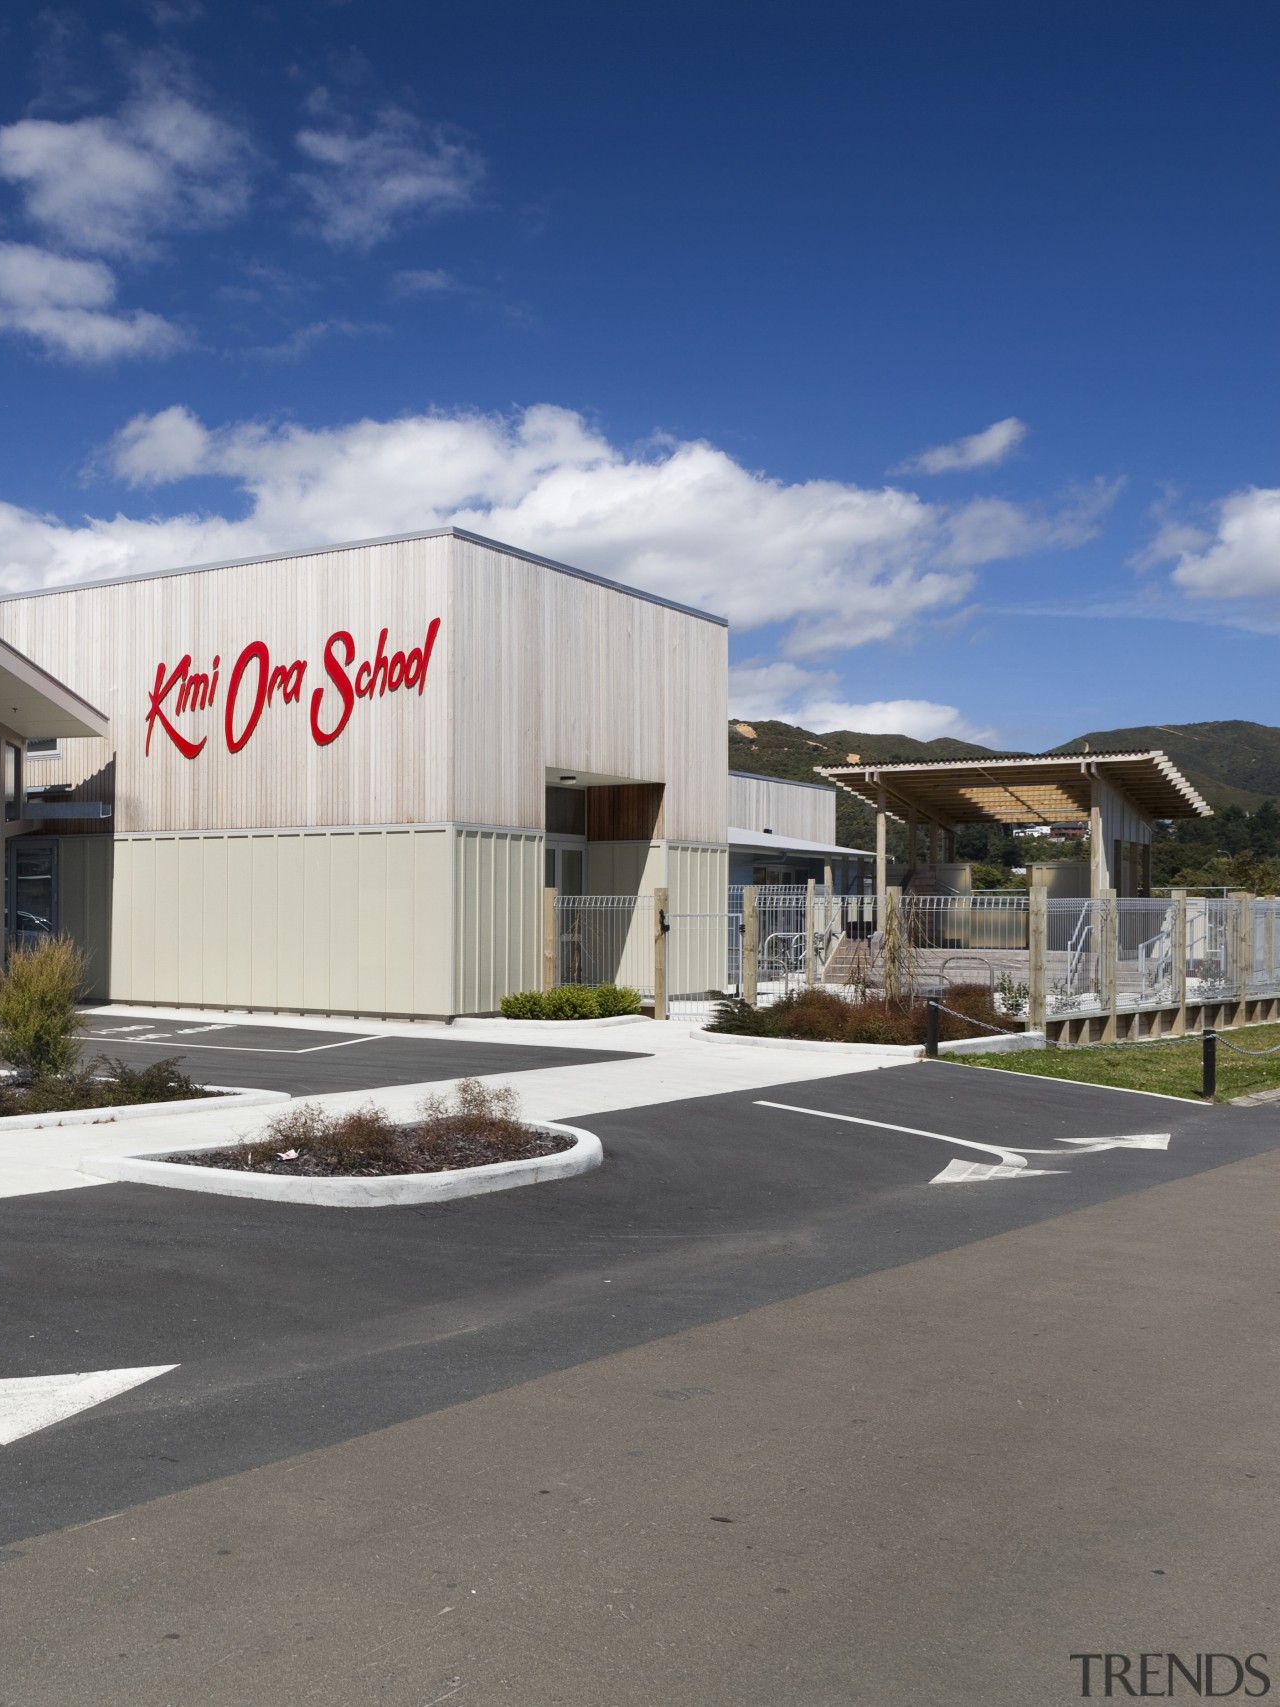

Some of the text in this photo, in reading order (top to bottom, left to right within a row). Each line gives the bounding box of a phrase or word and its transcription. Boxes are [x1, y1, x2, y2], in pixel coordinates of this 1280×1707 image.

[145, 617, 441, 759] Kimi Ora School
